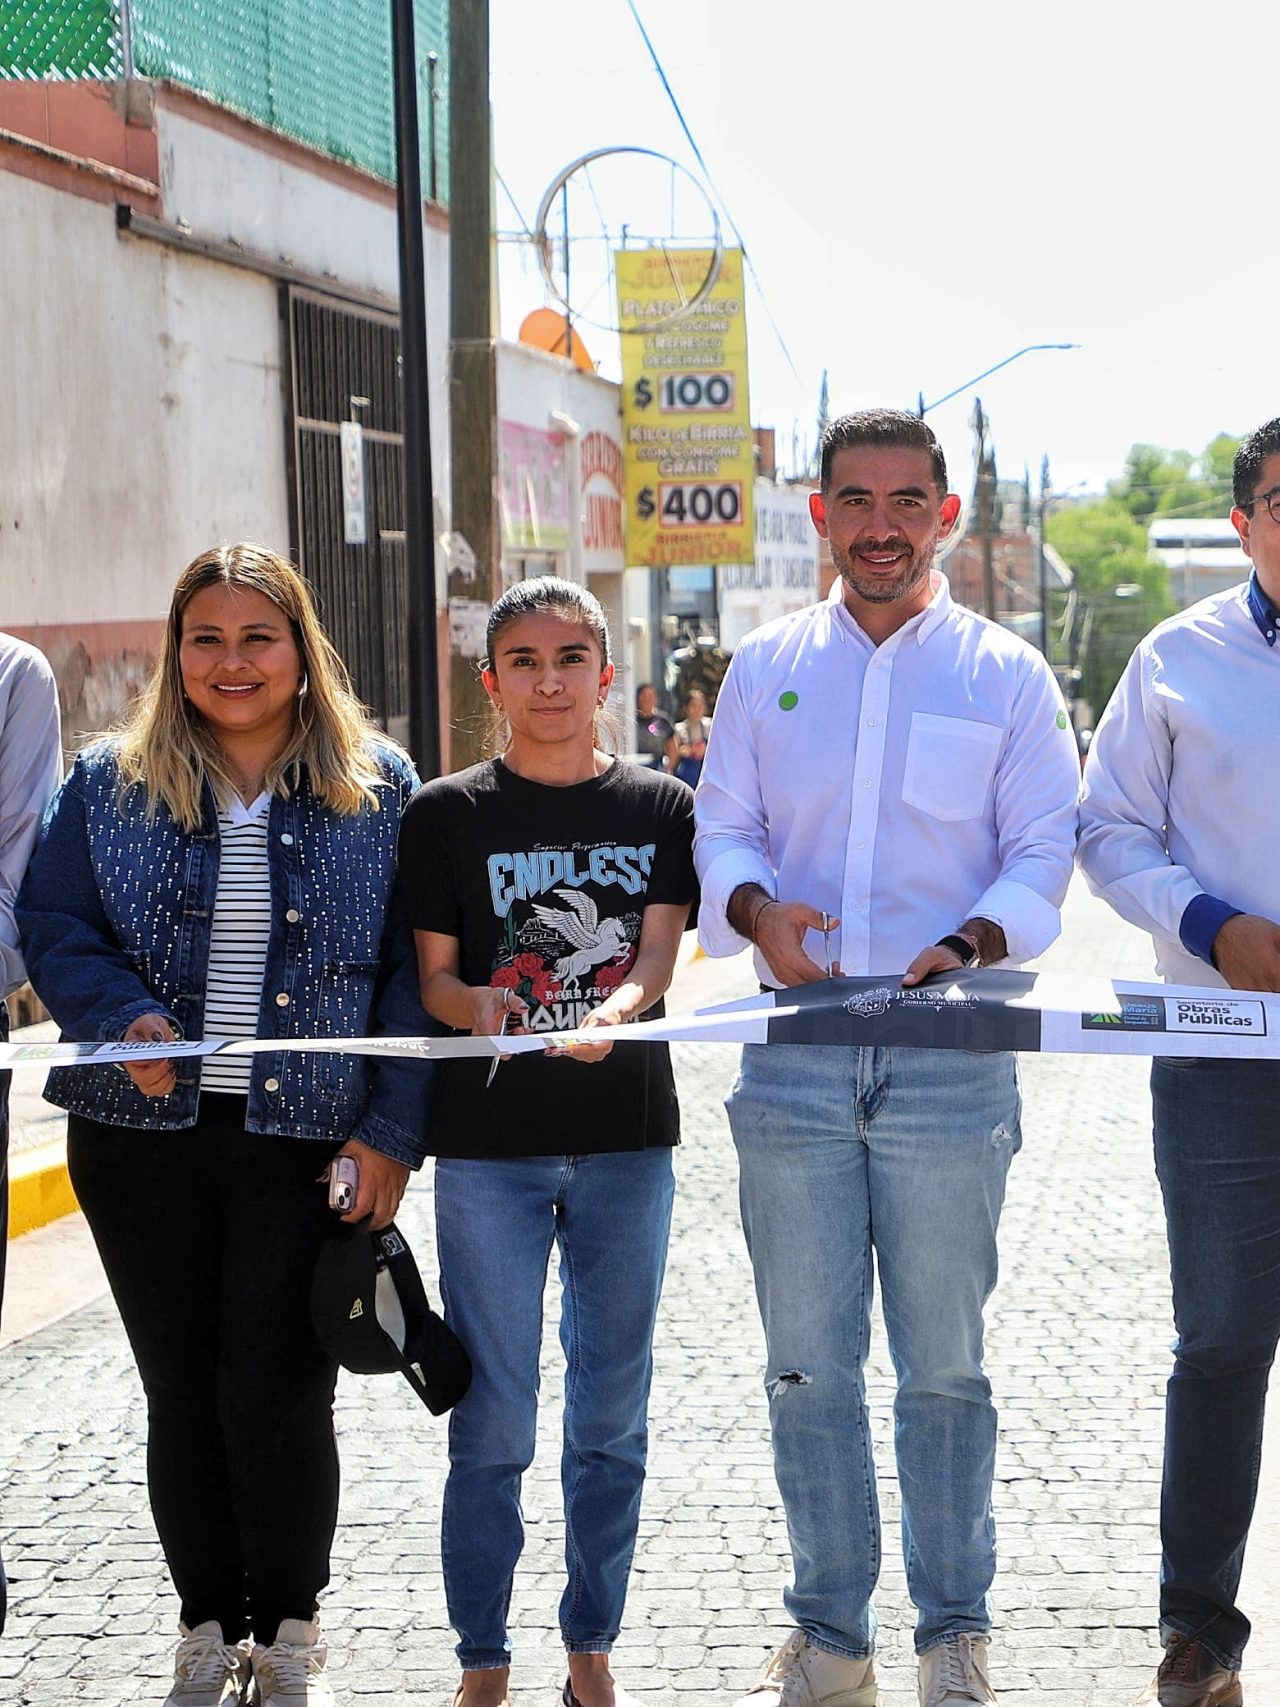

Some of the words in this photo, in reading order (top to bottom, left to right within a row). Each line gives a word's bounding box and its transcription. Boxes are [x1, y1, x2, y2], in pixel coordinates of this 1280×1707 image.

[684, 298, 740, 317] HICO
[665, 374, 730, 408] 100
[627, 424, 671, 444] KILO
[690, 423, 747, 442] BIRRIA
[657, 458, 721, 477] GRATIS
[664, 484, 739, 523] 400
[487, 843, 656, 918] ENDLESS
[895, 989, 933, 1000] JESÚS
[1177, 1004, 1231, 1014] Obras
[1178, 1012, 1253, 1027] Públicas
